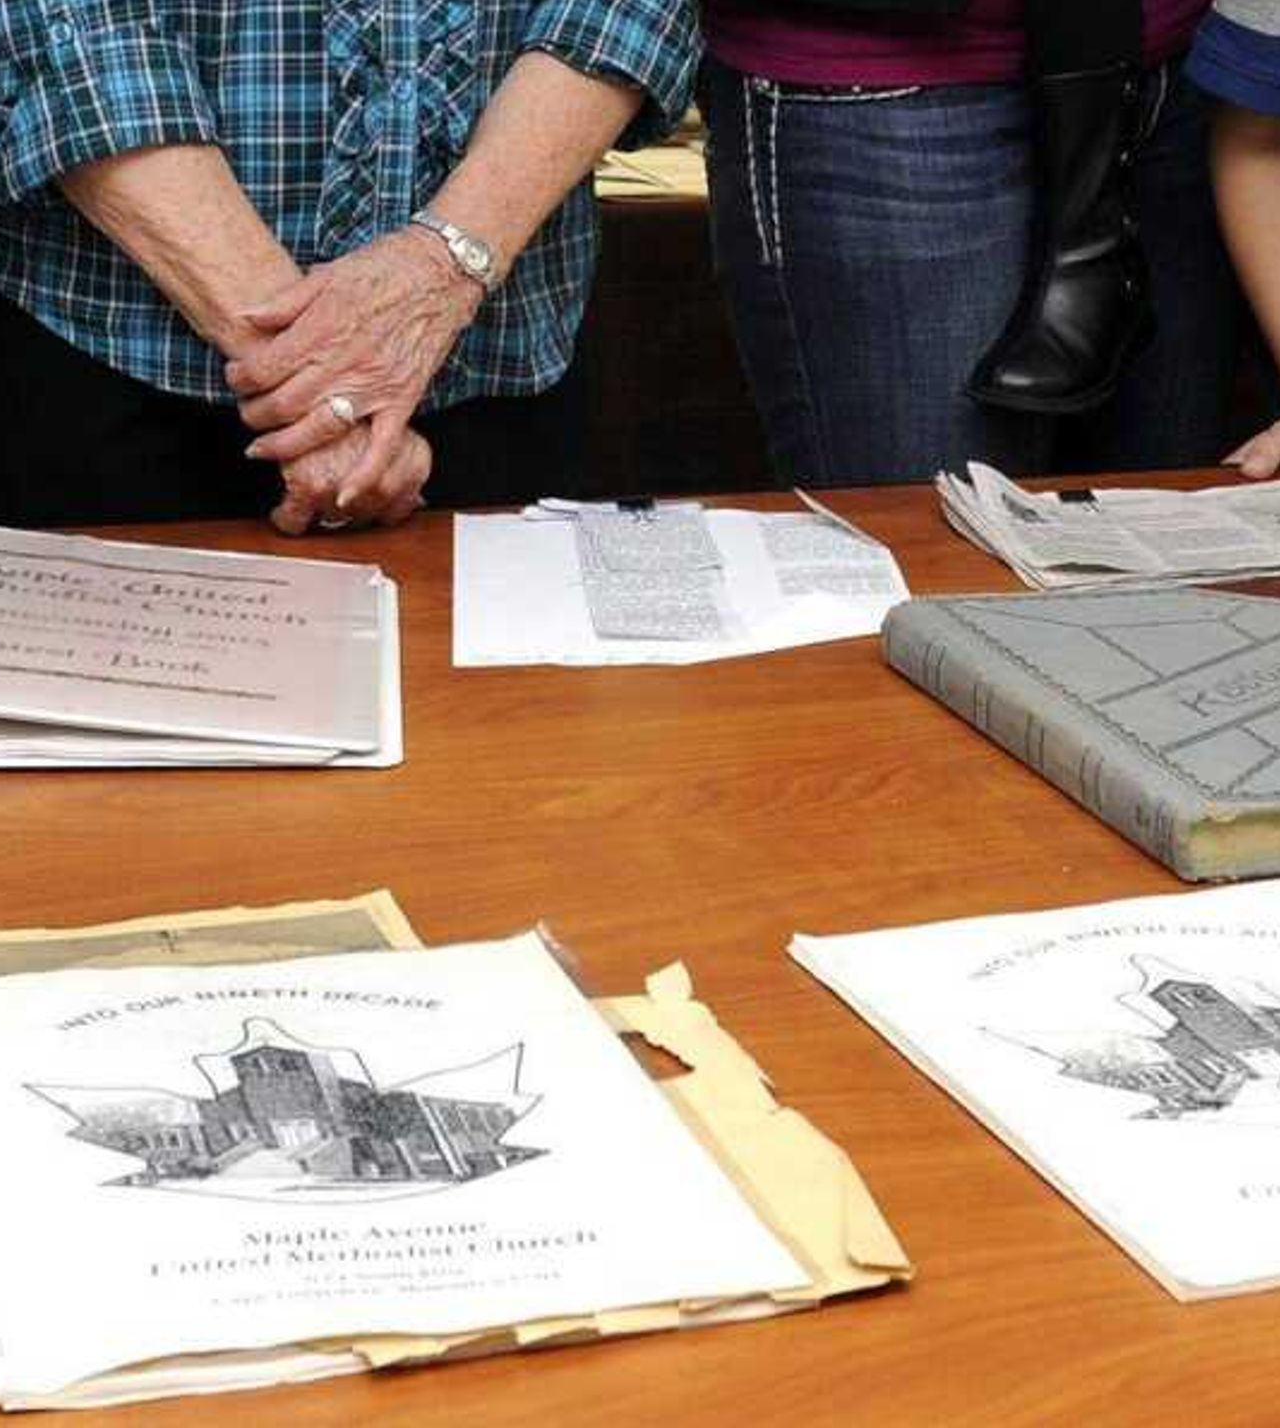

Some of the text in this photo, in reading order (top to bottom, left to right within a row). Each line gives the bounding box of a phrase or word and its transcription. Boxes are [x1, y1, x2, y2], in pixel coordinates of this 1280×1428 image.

[56, 988, 446, 1031] INTO OUR NINETH DECADE
[149, 1252, 271, 1277] United
[286, 1243, 453, 1265] Methodist
[465, 1228, 598, 1255] Church
[243, 1221, 487, 1246] Maple Avenue
